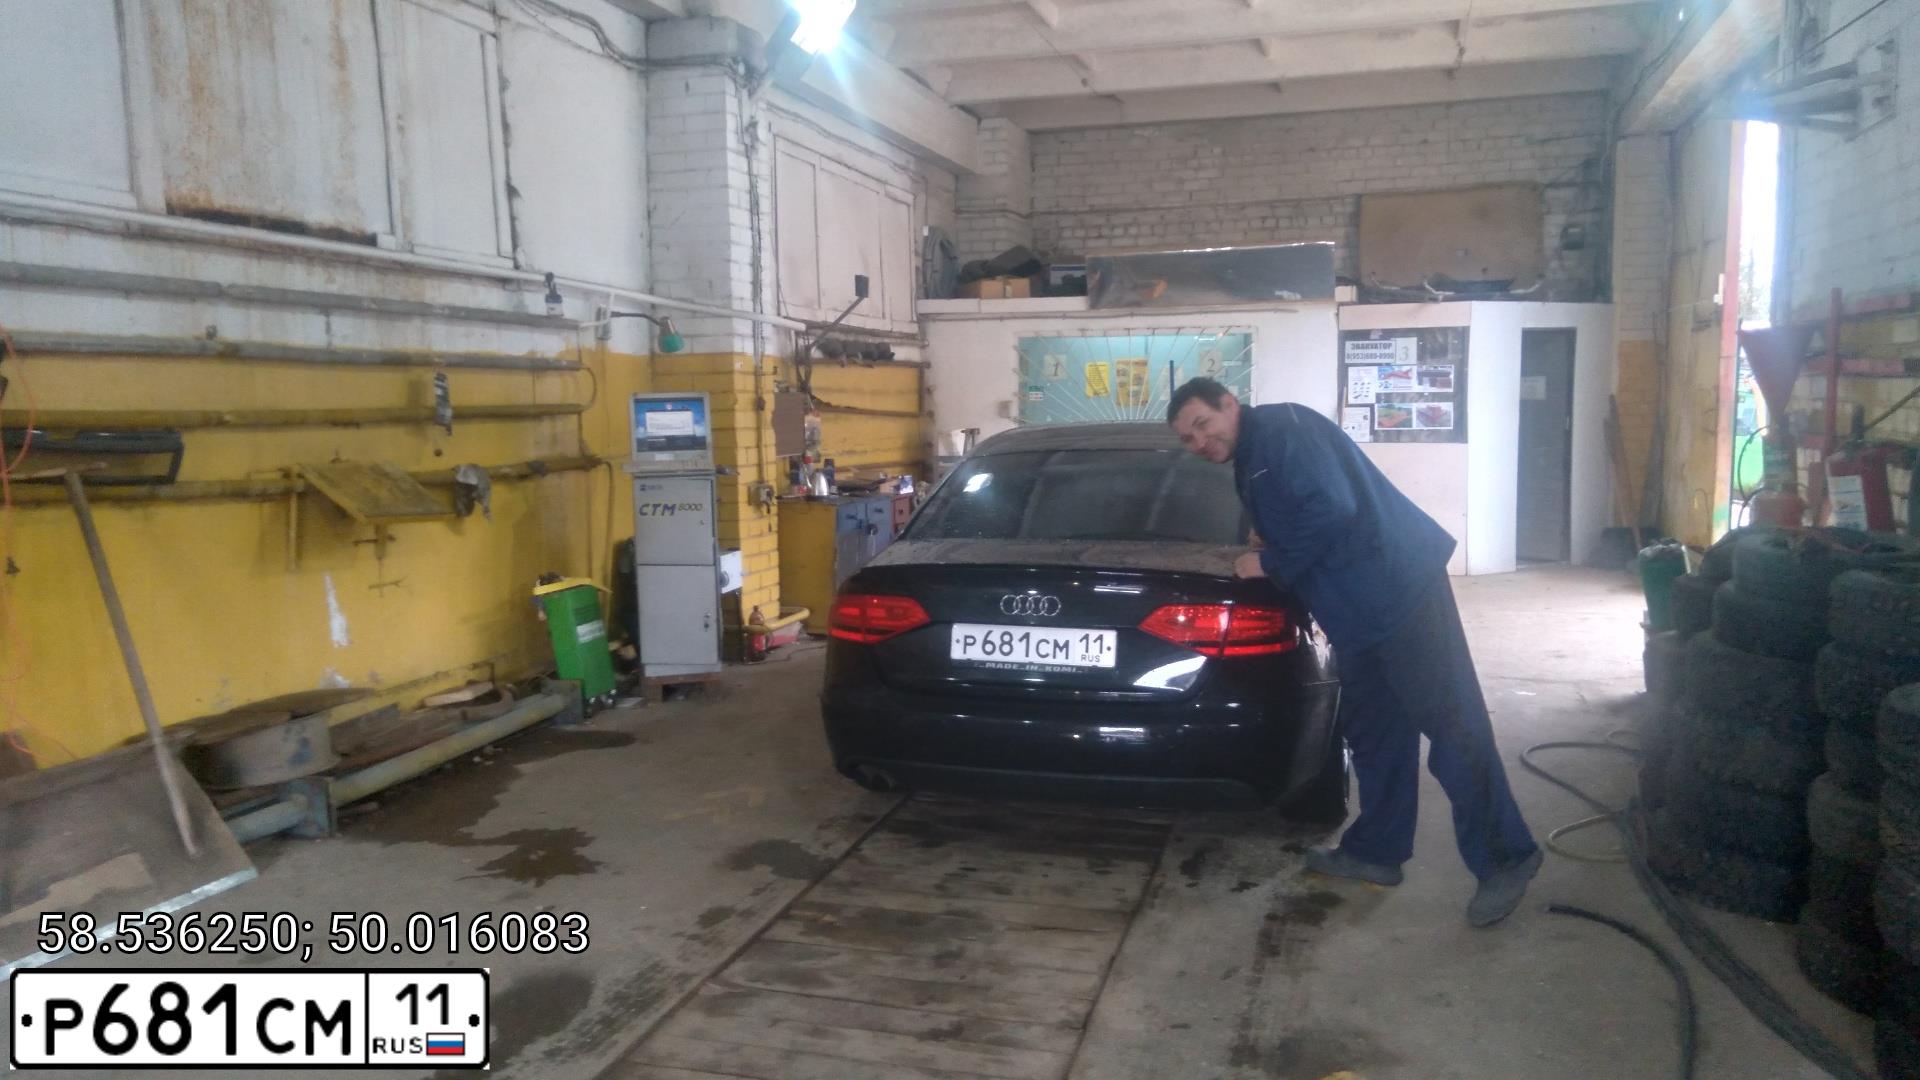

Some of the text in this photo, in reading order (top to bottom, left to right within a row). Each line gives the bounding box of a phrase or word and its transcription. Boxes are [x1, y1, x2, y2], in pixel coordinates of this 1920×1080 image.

[1400, 346, 1409, 361] 3
[1206, 358, 1216, 373] 2
[963, 630, 1104, 660] Р681СМ 11
[1081, 654, 1101, 663] RUS
